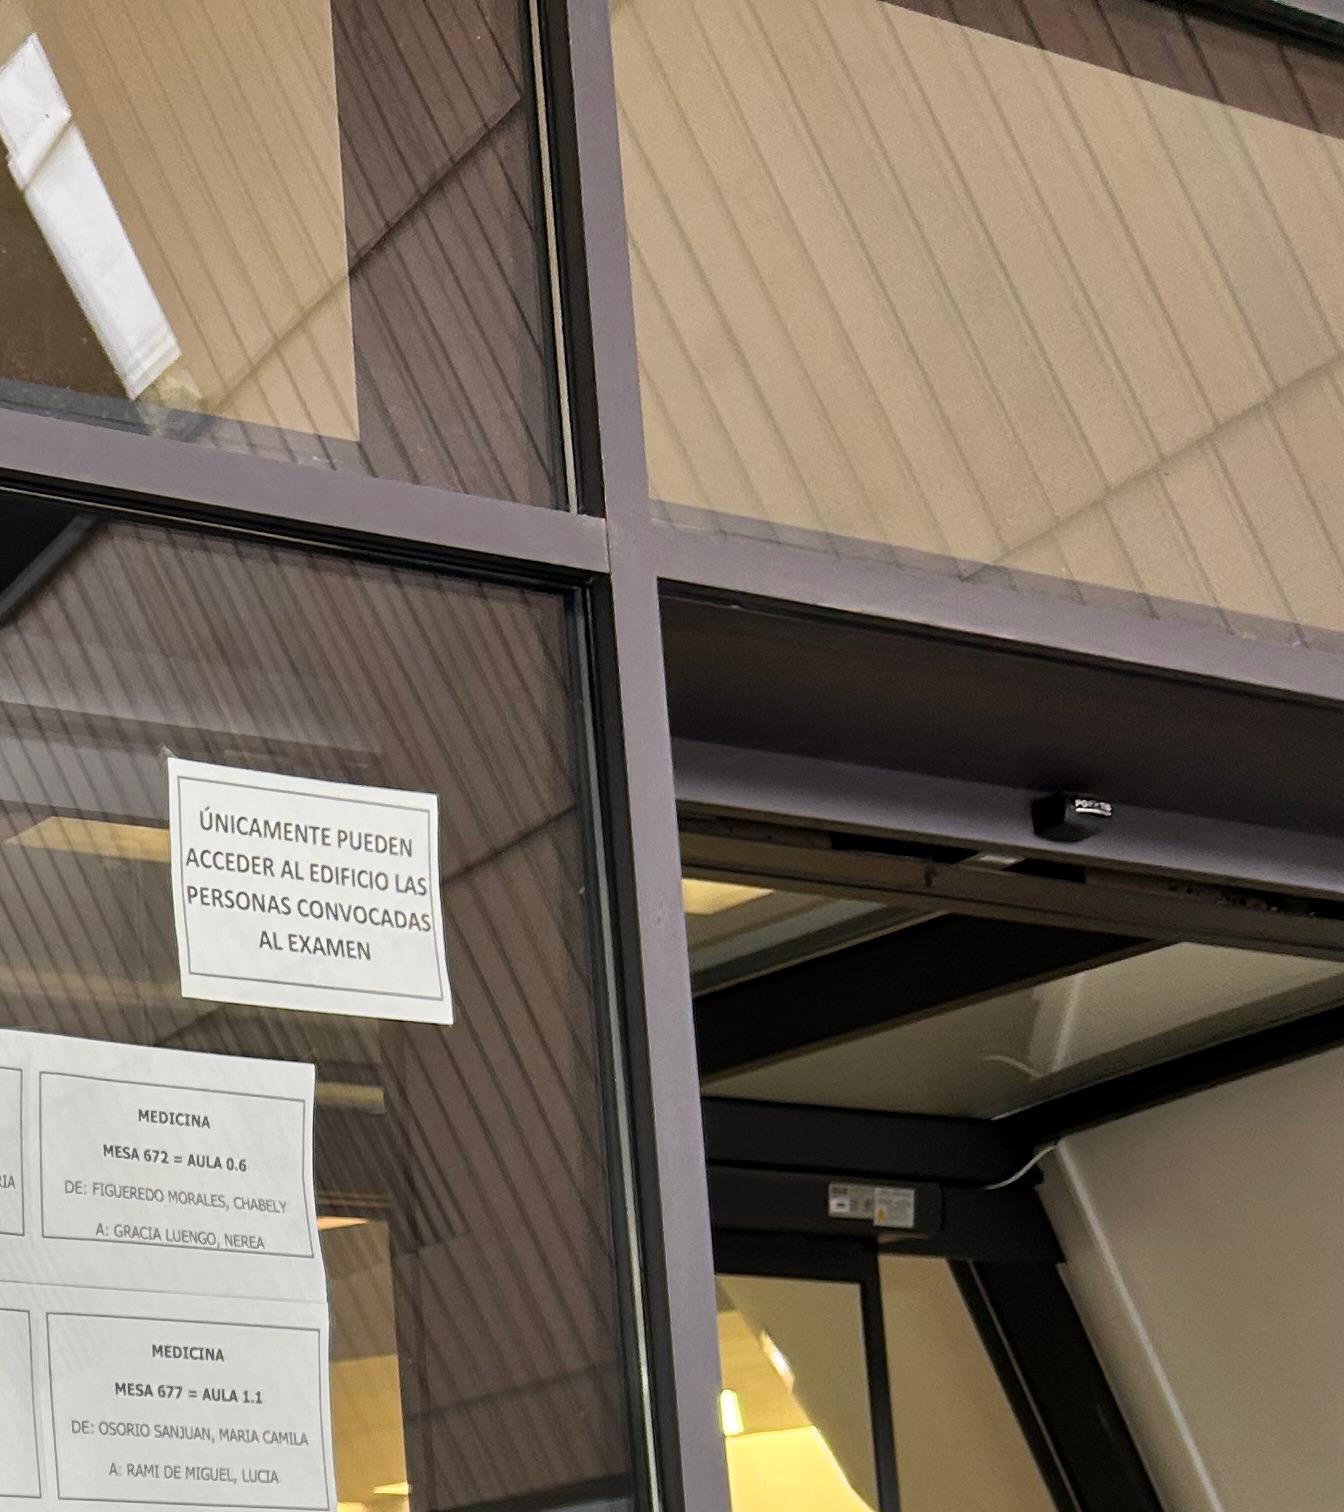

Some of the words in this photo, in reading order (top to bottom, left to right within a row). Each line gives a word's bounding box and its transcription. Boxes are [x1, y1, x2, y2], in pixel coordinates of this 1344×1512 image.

[200, 806, 331, 847] ÚNICAMENTE
[337, 829, 412, 858] PUEDEN
[185, 848, 275, 877] ACCEDER
[280, 860, 304, 881] AL
[310, 863, 389, 891] EDIFICIO
[395, 873, 427, 895] LAS
[187, 885, 292, 916] PERSONAS
[297, 899, 431, 932] CONVOCADAS
[259, 930, 284, 951] AL
[288, 933, 371, 961] EXAMEN
[138, 1109, 211, 1129] MEDICINA
[103, 1144, 140, 1161] MESA
[143, 1149, 169, 1164] 672
[187, 1154, 223, 1169] AULA
[226, 1157, 247, 1172] 0.6
[64, 1180, 87, 1195] DE:
[92, 1182, 165, 1203] FIGUEREDO
[167, 1190, 230, 1211] MORALES,
[233, 1196, 287, 1214] CHABELY
[96, 1223, 109, 1236] A:
[114, 1224, 161, 1240] GRACIA
[165, 1228, 220, 1248] LUENGO,
[225, 1234, 265, 1249] NEREA
[152, 1344, 225, 1362] MEDICINA
[115, 1382, 154, 1397] MESA
[157, 1384, 183, 1399] 677
[188, 1390, 197, 1398] =
[202, 1388, 238, 1403] AULA
[243, 1390, 263, 1404] 1.1
[71, 1420, 94, 1434] DE:
[98, 1421, 150, 1438] OSORIO
[154, 1424, 215, 1444] SANJUAN,
[219, 1428, 260, 1443] MARIA
[262, 1430, 309, 1446] CAMILA
[109, 1462, 122, 1477] A:
[126, 1463, 160, 1479] RAMI
[163, 1464, 182, 1479] DE
[185, 1466, 237, 1485] MIGUEL,
[242, 1468, 279, 1484] LUCIA
